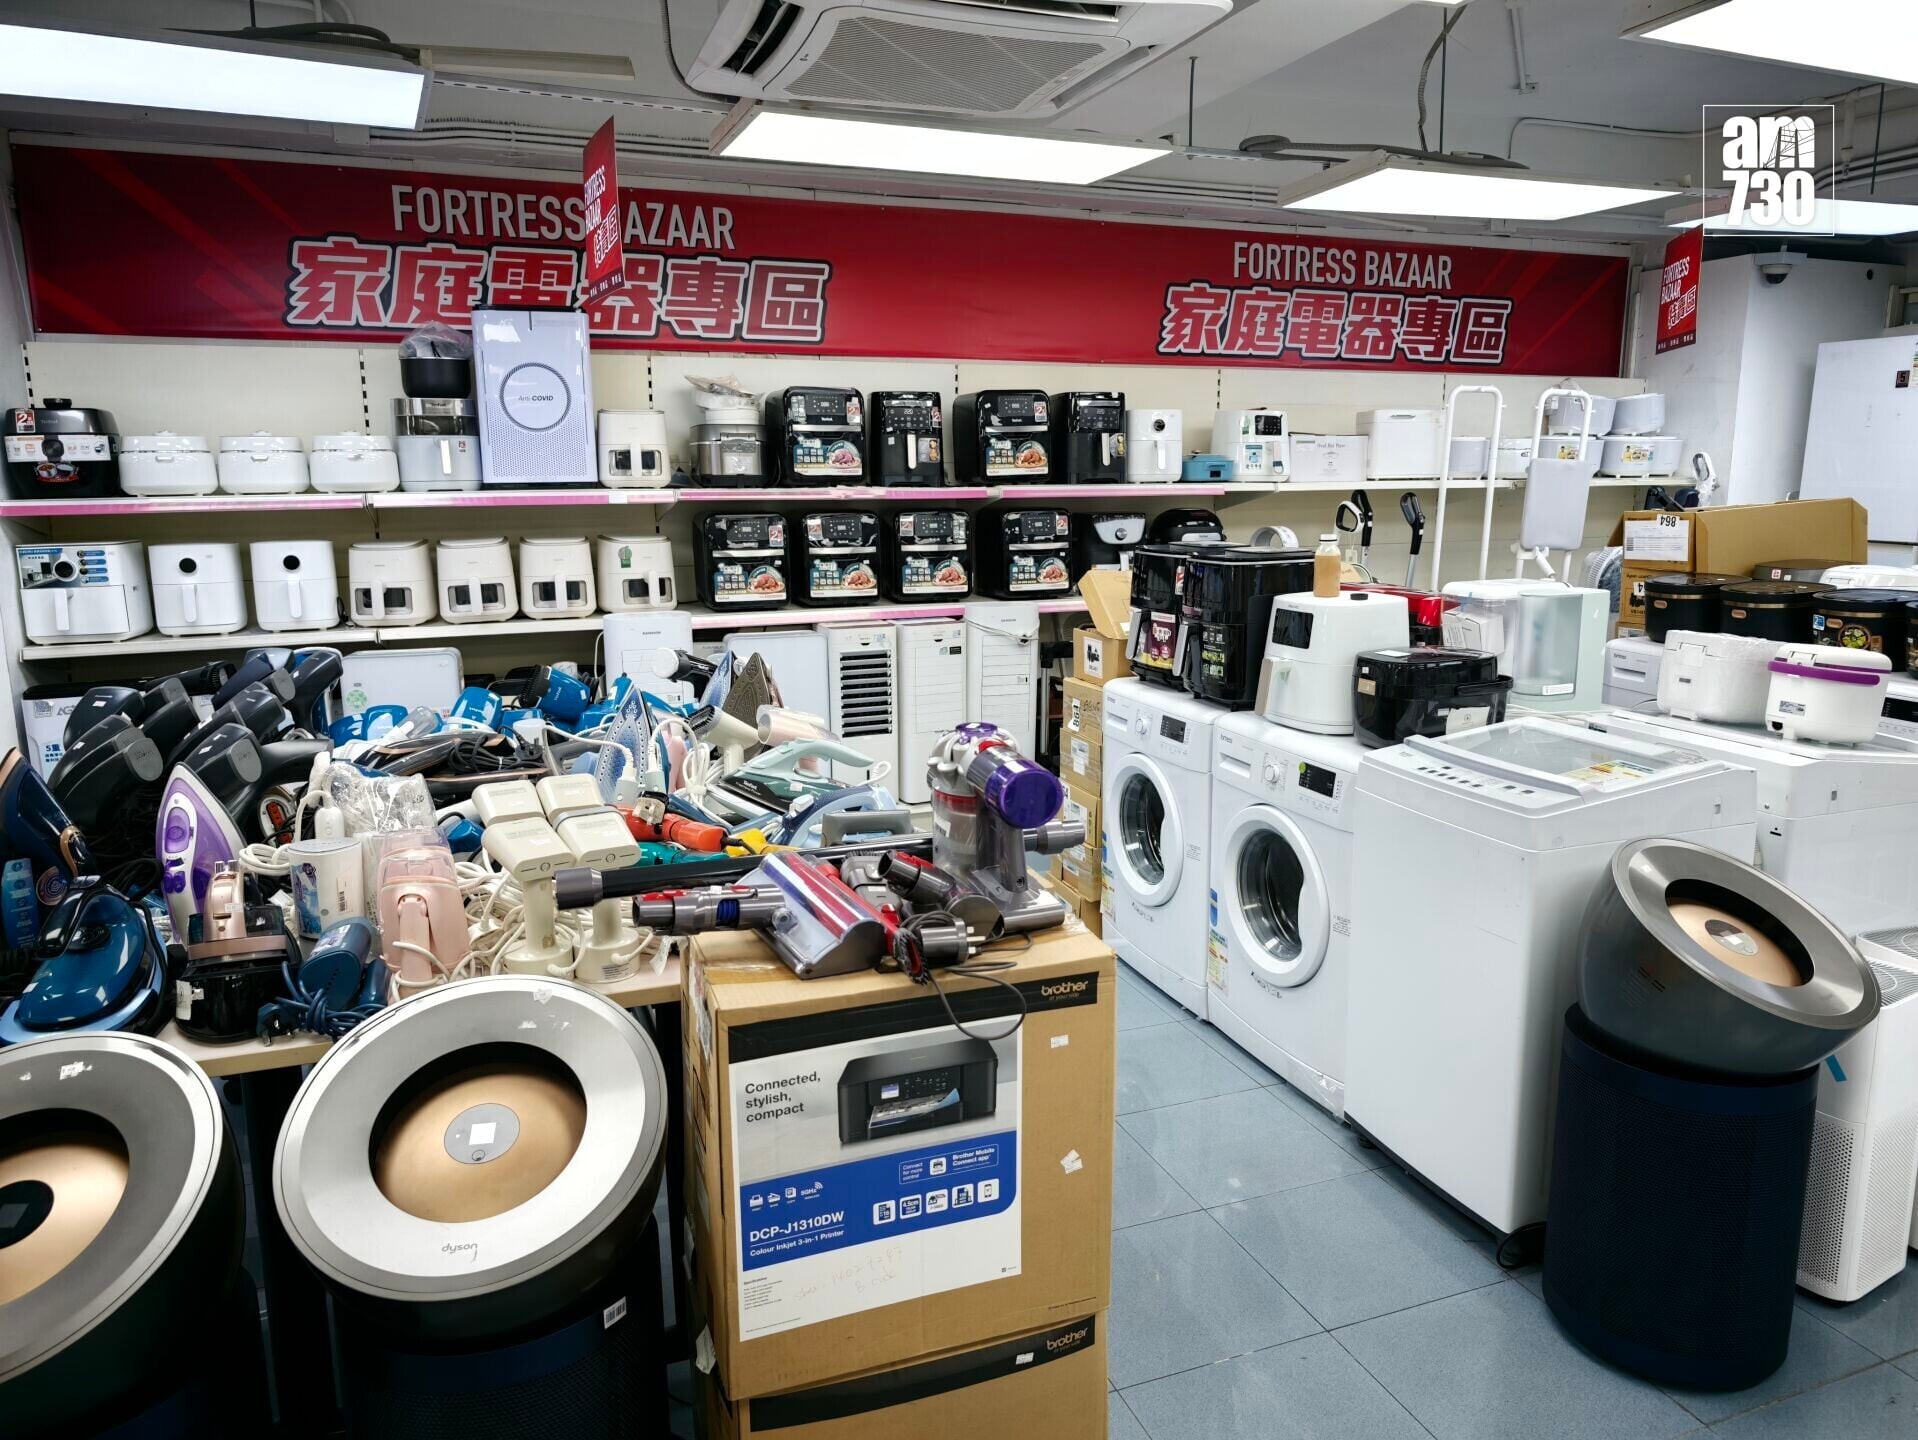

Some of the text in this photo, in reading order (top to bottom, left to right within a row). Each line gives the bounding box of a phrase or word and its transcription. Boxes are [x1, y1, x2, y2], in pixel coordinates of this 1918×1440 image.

[583, 165, 606, 206] FORTRESS
[391, 184, 735, 250] FORTRESS AZAAR
[1234, 241, 1452, 290] FORTRESS BAZAAR
[1663, 256, 1690, 285] FORTRESS
[1661, 279, 1682, 305] BAZAAR
[1158, 282, 1512, 363] 家庭電器專區
[1660, 515, 1677, 527] 864
[1041, 980, 1089, 996] brother
[745, 1071, 821, 1094] Connected,
[745, 1091, 792, 1109] stylish,
[746, 1102, 805, 1123] compact
[952, 1148, 995, 1161] Brother Mobile
[952, 1158, 977, 1167] Connect
[749, 1210, 845, 1242] DCP-J1310DW
[441, 1242, 478, 1263] dyson
[750, 1230, 845, 1257] Colour Inkjet 3-in-1 Printer
[1046, 1327, 1089, 1351] brother
